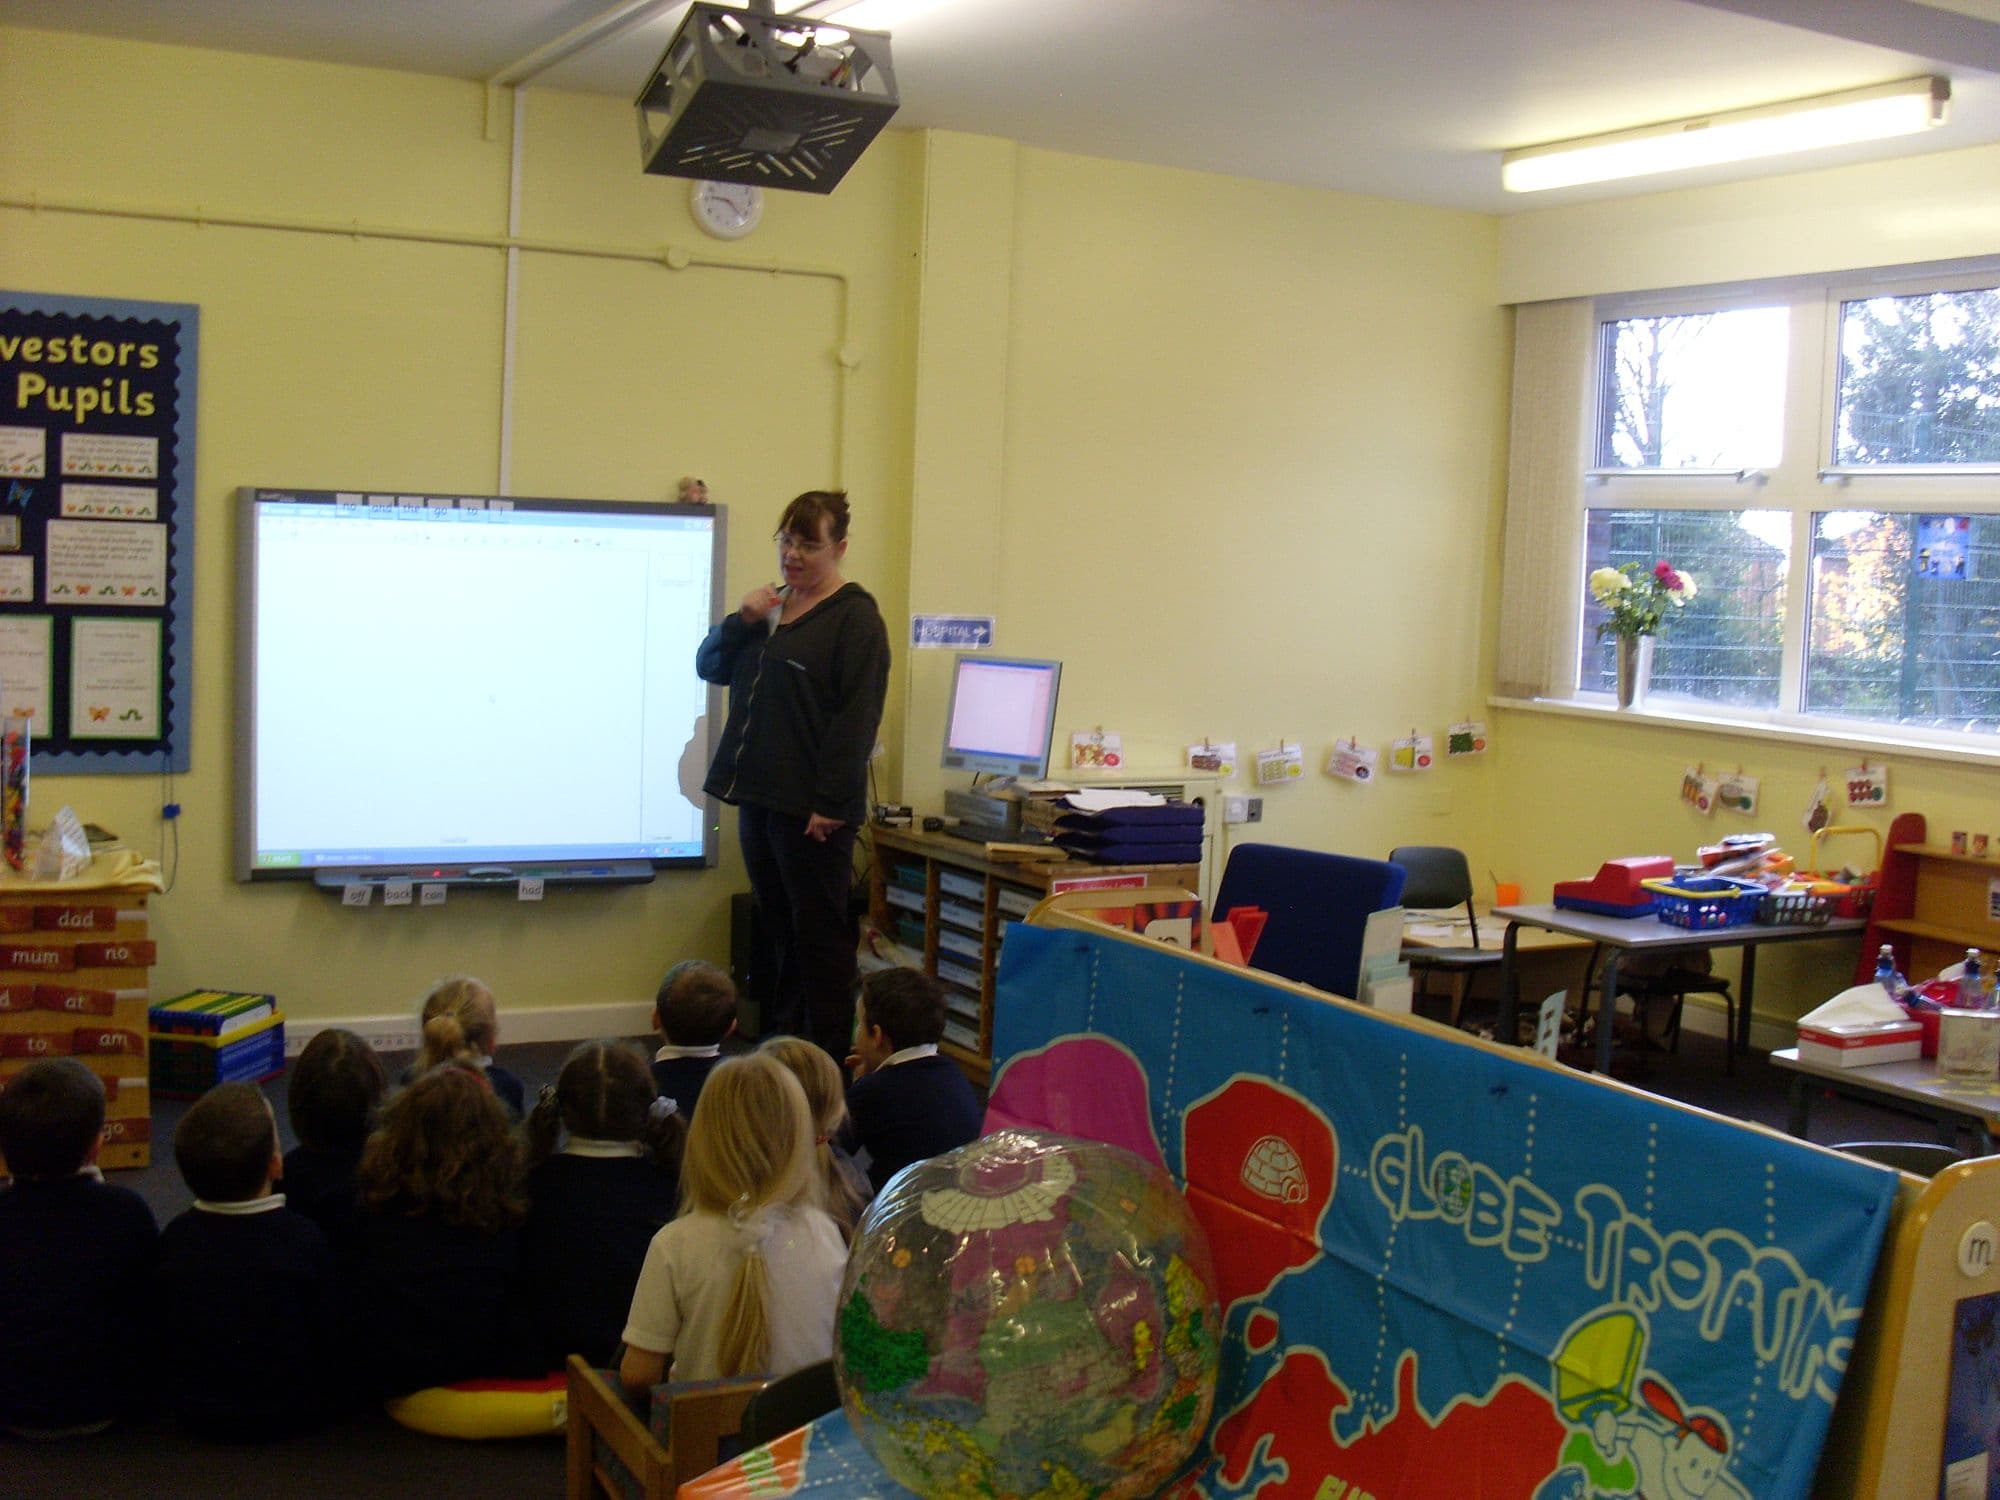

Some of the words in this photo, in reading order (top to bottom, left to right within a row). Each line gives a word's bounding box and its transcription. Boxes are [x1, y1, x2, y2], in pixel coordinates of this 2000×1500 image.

[16, 372, 156, 424] Pupils
[916, 624, 972, 639] HOSPITAL
[58, 911, 94, 927] dad
[12, 950, 59, 964] mum
[105, 945, 129, 960] no
[64, 993, 84, 1009] at
[28, 1036, 47, 1051] to
[99, 1031, 128, 1047] am
[1369, 1124, 1562, 1263] GLOBE
[1968, 1236, 1991, 1266] m
